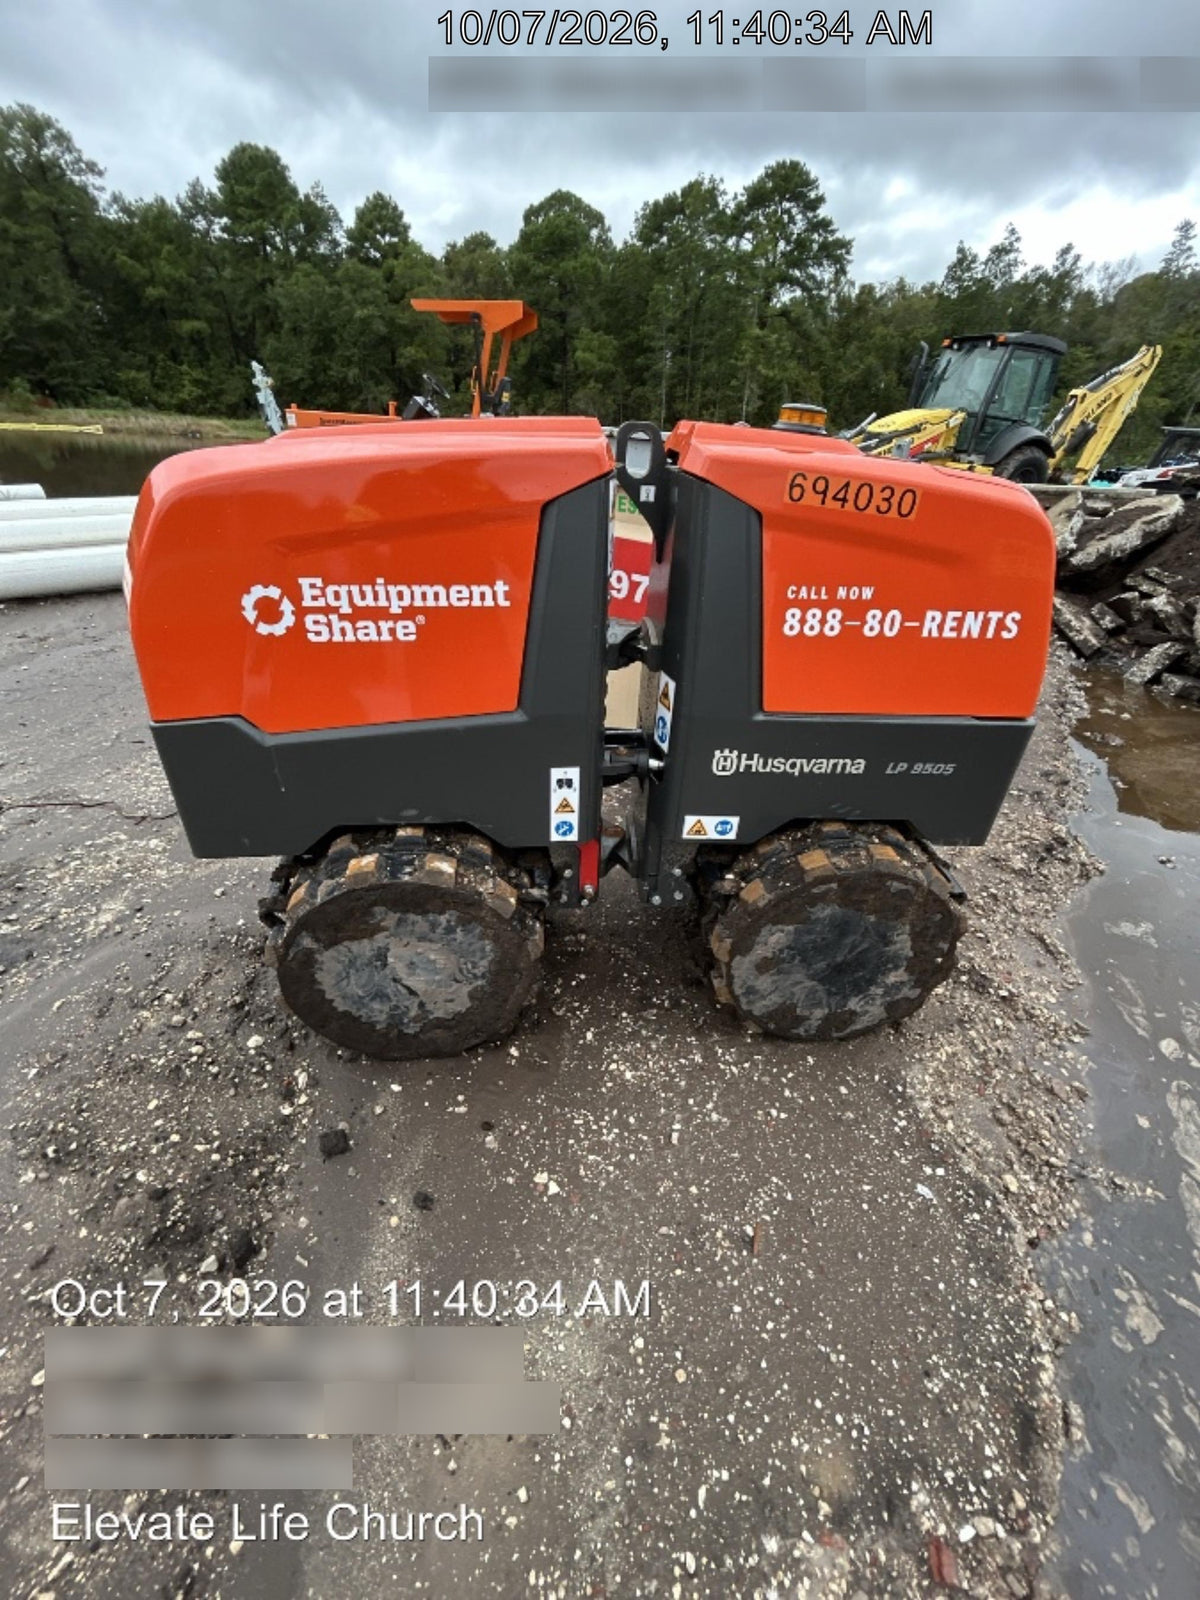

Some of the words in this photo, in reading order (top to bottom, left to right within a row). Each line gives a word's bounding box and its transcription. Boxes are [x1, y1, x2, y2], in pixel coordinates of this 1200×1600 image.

[787, 472, 918, 519] 694030
[297, 577, 511, 615] Equipment
[609, 569, 650, 604] 97
[786, 585, 829, 600] CALL
[837, 585, 875, 600] NOW
[782, 607, 1021, 639] 888-80-RENTS
[739, 753, 867, 777] Husqvarna
[885, 762, 909, 775] LP
[910, 762, 957, 776] 9505
